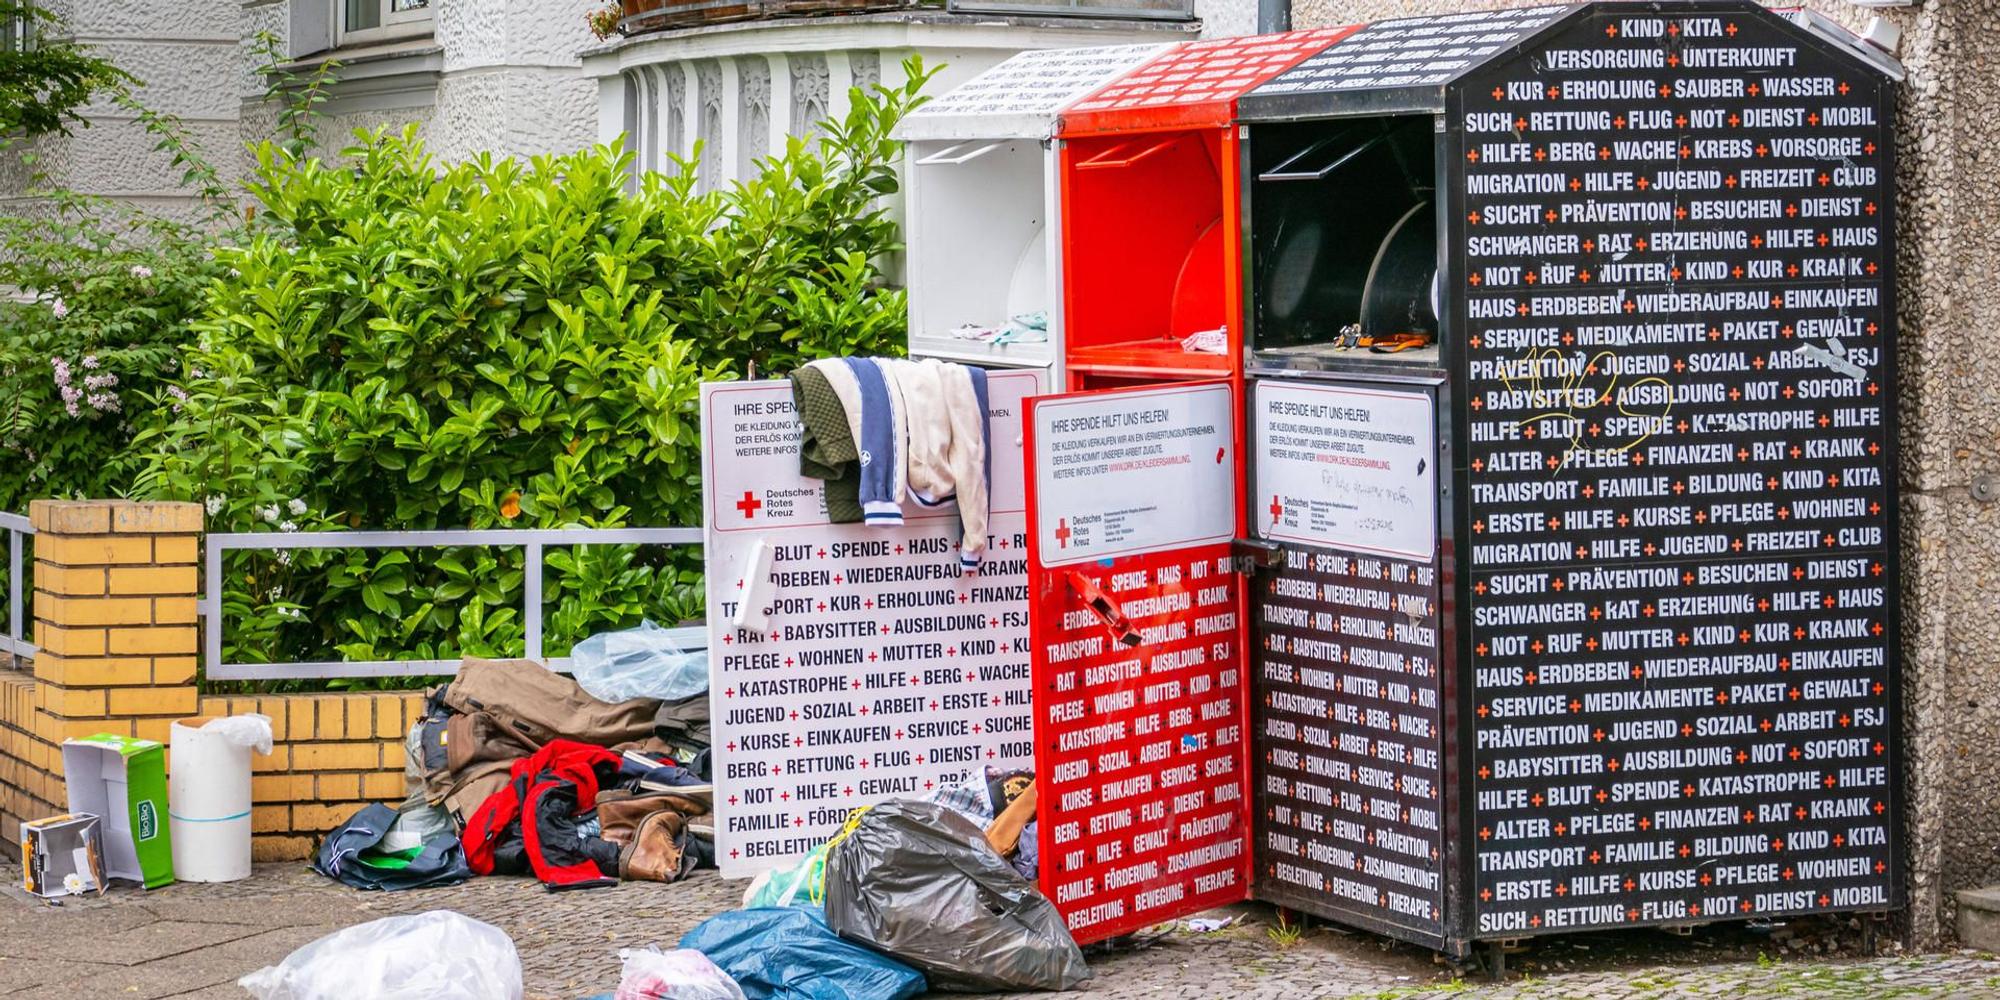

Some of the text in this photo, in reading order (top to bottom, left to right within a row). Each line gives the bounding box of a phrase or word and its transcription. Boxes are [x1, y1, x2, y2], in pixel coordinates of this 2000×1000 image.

[1621, 18, 1723, 38] KIND KITA
[1545, 48, 1796, 68] VERSORGUNG UNTERKUNFT
[1508, 77, 1834, 101] KUR ERHOLUNG SAUBER WASSER
[1465, 107, 1876, 133] SUCH RETTUNG FLUG NOT DIENST MOBIL
[1484, 197, 1862, 225] SUCHT PRÄVENTION BESUCHEN DIENST
[735, 403, 762, 416] IHRE
[1052, 409, 1168, 433] IHRE SPENDE HILFT UNS HELFEN!
[1269, 401, 1283, 414] IHRE
[1284, 402, 1309, 416] SPENDE
[1311, 405, 1327, 418] HILFT
[1329, 406, 1343, 420] UNS
[735, 423, 748, 432] DIE
[750, 421, 791, 432] KLEIDUNG
[736, 436, 752, 444] DER
[754, 432, 781, 444] ERLÖS
[736, 445, 798, 456] WEITERE INFOS
[766, 488, 814, 498] Deutsches
[1471, 467, 1881, 503] TRANSPORT FAMILIE BILDUNG KIND KITA
[767, 499, 793, 508] Rotes
[767, 509, 793, 518] Kreuz
[1284, 496, 1309, 508] Deutsches
[1284, 507, 1298, 517] Rotes
[1073, 514, 1101, 525] Deutsches
[1073, 527, 1089, 536] Rotes
[1284, 518, 1298, 528] Kreuz
[775, 537, 948, 561] BLUT SPENDE HAUS
[1074, 538, 1089, 547] Kreuz
[1288, 550, 1434, 587] BLUT SPENDE HAUS NOT RUF
[1490, 559, 1868, 595] SUCHT PRÄVENTION BESUCHEN DIENST
[785, 611, 1028, 641] BABYSITTER AUSBILDUNG FSJ
[1057, 642, 1229, 692] RAT BABYSITTER AUSBILDUNG FSJ
[1271, 634, 1428, 677] RAT BABYSITTER AUSBILDUNG FSJ
[1476, 647, 1883, 688] HAUS ERDBEBEN WIEDERAUFBAU EINKAUFEN
[740, 664, 1029, 697] KATASTROPHE HILFE BERG WACHE
[1492, 678, 1870, 718] SERVICE MEDIKAMENTE PAKET GEWALT
[741, 716, 1031, 751] KURSE EINKAUFEN SERVICE SUCHE
[1477, 707, 1884, 749] PRÄVENTION JUGEND SOZIAL ARBEIT FSJ
[728, 761, 766, 779] BERG
[787, 755, 854, 774] RETTUNG
[874, 751, 910, 768] FLUG
[930, 745, 981, 763] DIENST
[1273, 748, 1430, 799] KURSE EINKAUFEN SERVICE SUCHE
[1478, 767, 1885, 810] HILFE BLUT SPENDE KATASTROPHE HILFE
[1055, 782, 1241, 844] BERG RETTUNG FLUG DIENST MOBIL
[1057, 838, 1242, 904] FAMILIE FÖRDERUNG ZUSAMMENKUNFT
[1068, 868, 1235, 930] BEGLEITUNG BEWEGUNG THERAPIE
[1277, 862, 1431, 920] BEGLEITUNG BEWEGUNG THERAPIE
